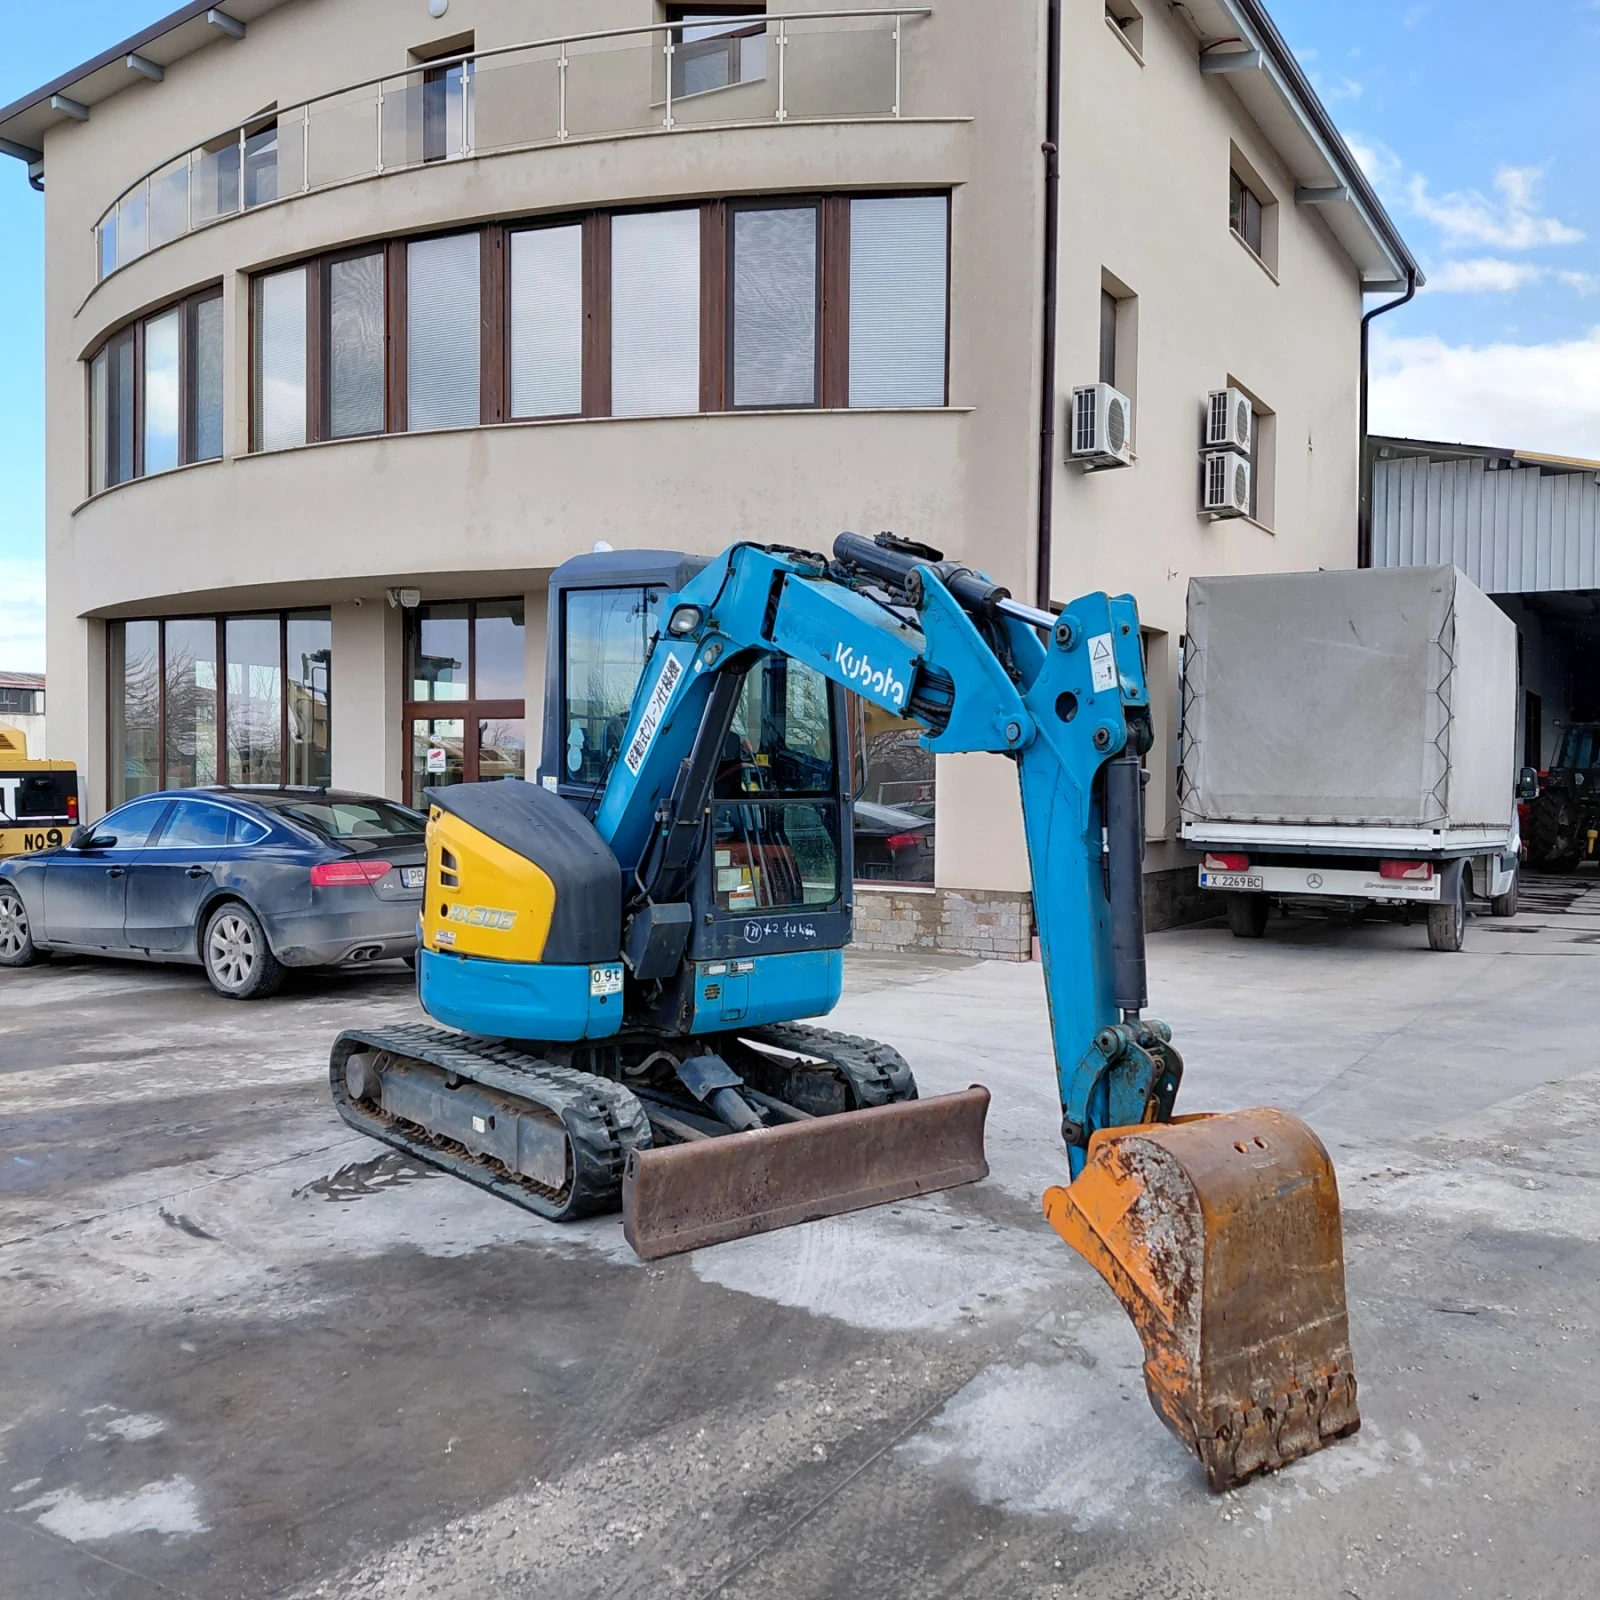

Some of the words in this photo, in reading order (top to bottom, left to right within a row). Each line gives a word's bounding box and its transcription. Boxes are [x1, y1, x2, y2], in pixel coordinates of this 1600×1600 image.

[835, 641, 904, 705] Kubota
[626, 658, 680, 772] 移動式クレーン仕様機
[1222, 876, 1246, 887] 2269
[1247, 877, 1261, 888] BC
[449, 903, 518, 931] RX306
